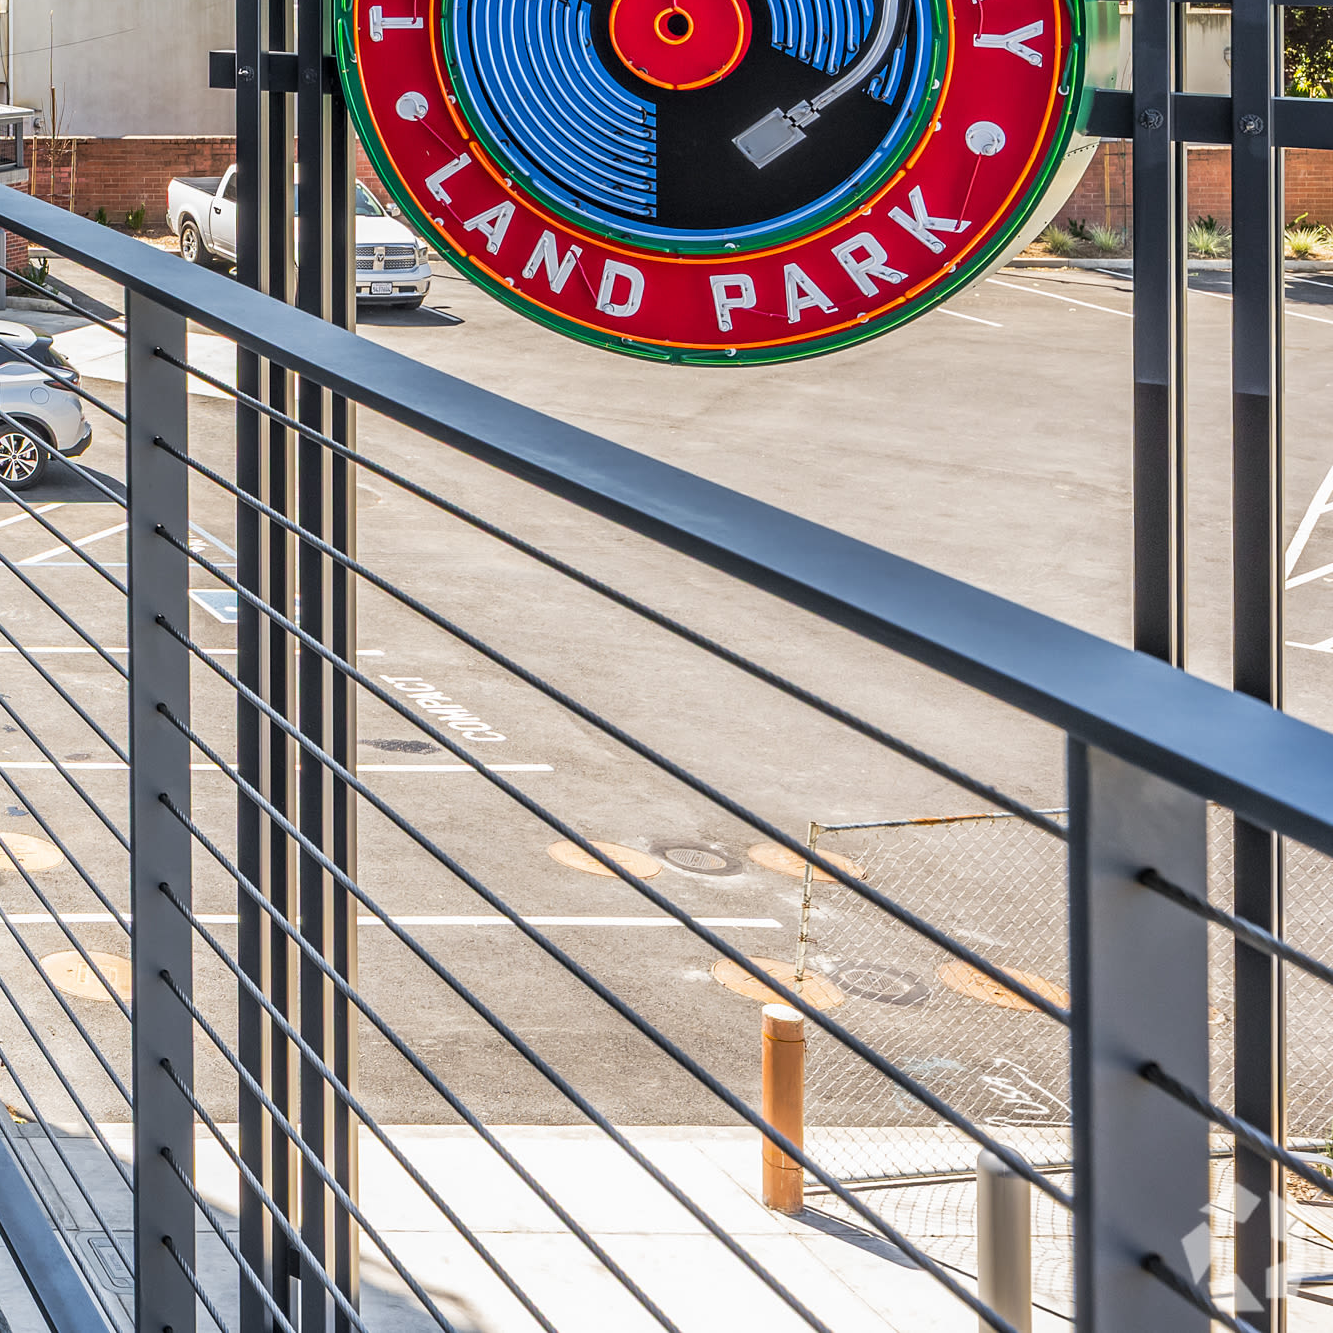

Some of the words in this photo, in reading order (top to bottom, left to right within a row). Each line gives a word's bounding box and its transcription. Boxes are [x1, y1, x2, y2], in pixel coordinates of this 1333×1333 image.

[425, 153, 645, 319] LAND
[710, 184, 971, 332] PARK
[379, 674, 507, 742] COMPACT
